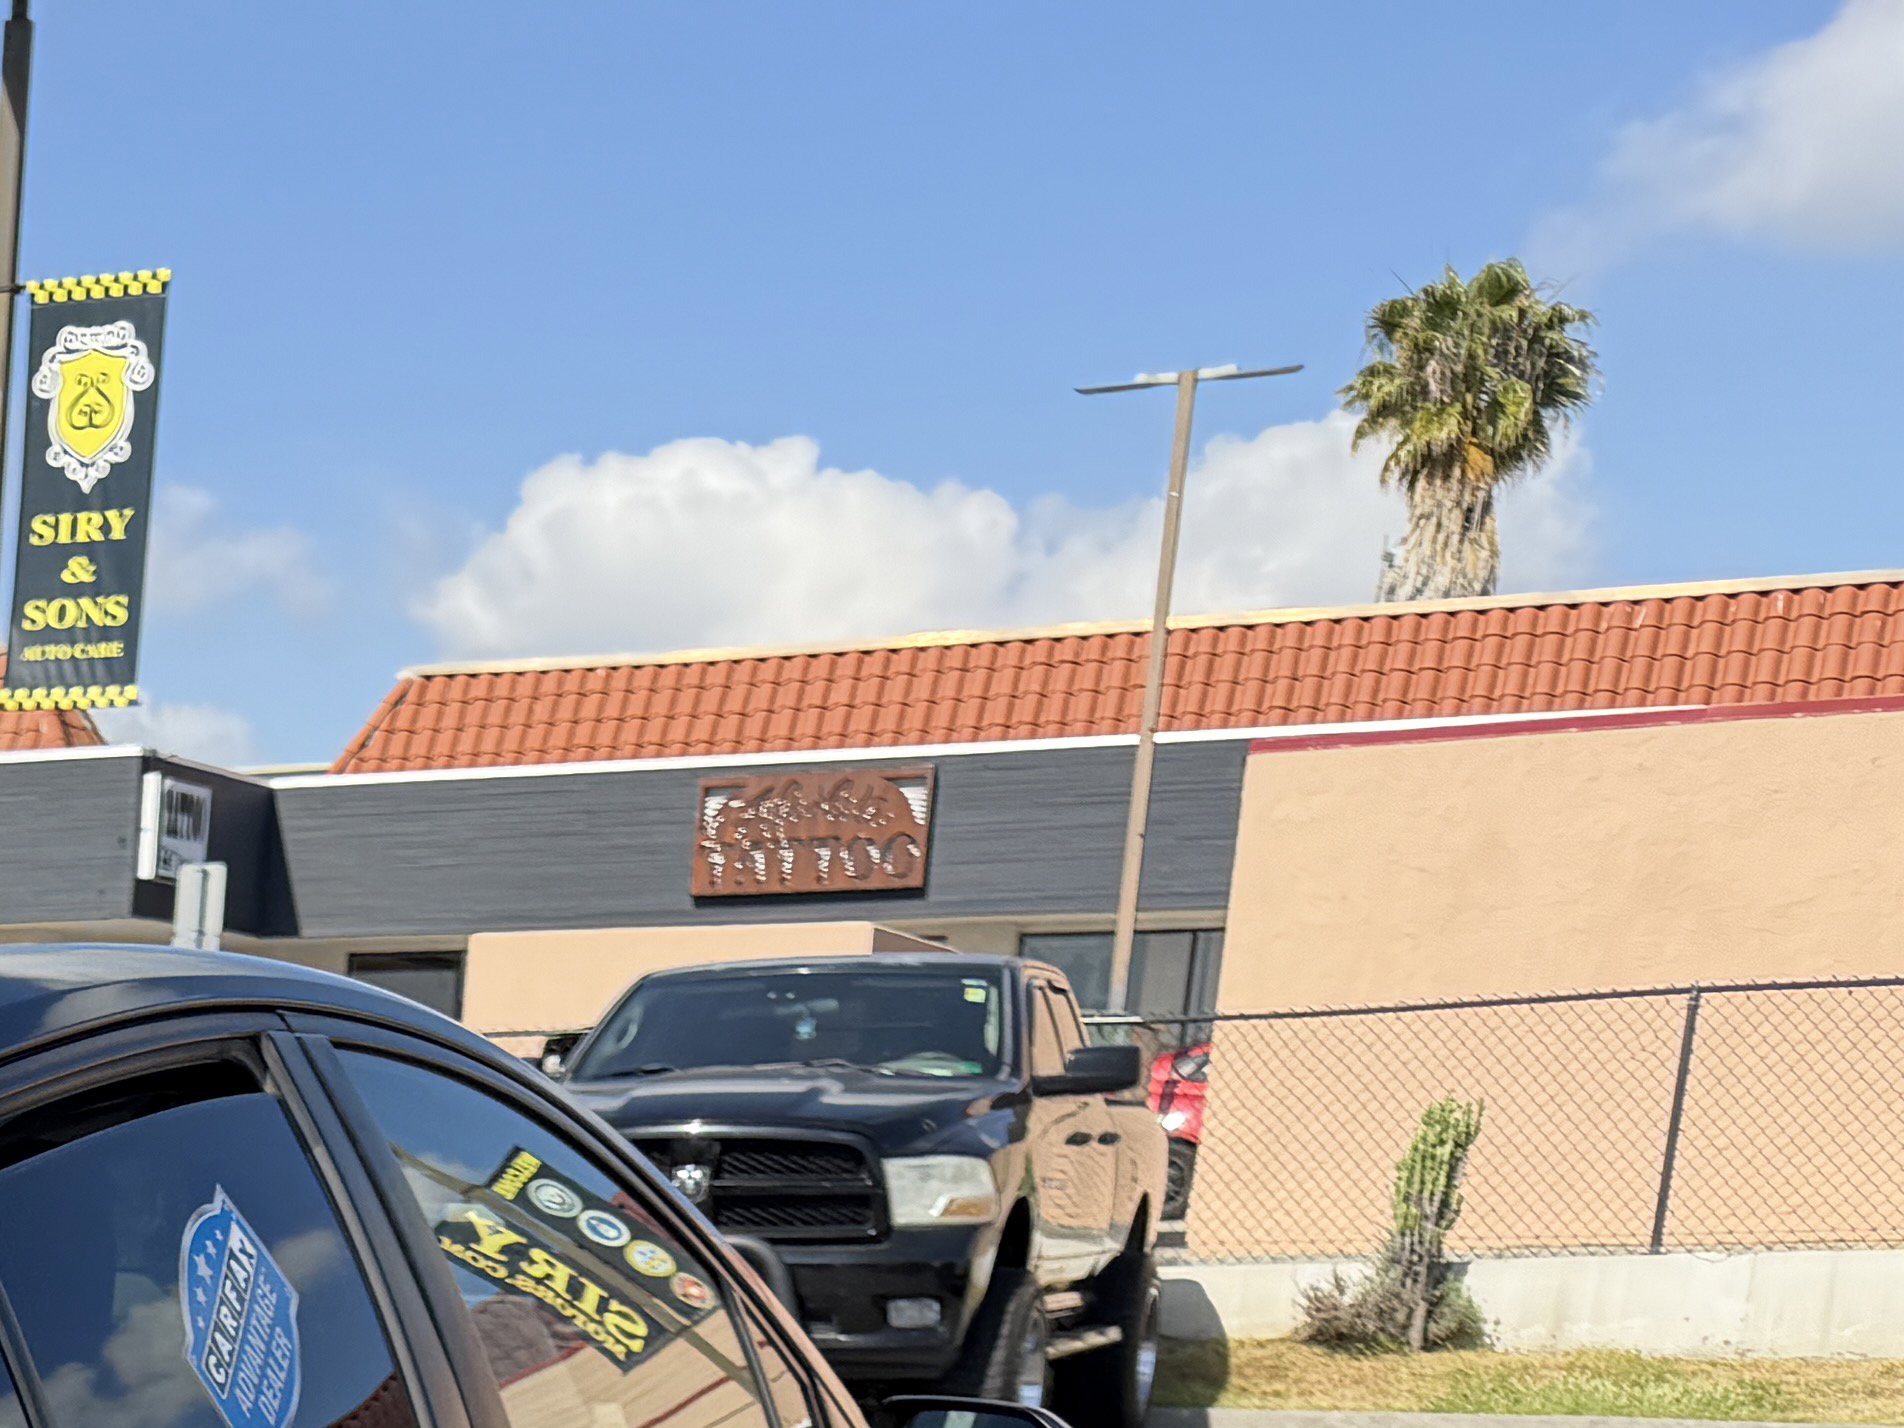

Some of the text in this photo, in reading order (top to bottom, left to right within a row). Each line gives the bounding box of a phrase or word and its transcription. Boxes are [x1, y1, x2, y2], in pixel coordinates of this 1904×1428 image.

[29, 507, 135, 546] SIRY
[60, 556, 97, 584] &
[22, 594, 129, 631] SONS
[205, 1221, 258, 1386] CARFAX
[234, 1278, 278, 1419] ADVANTAGE
[258, 1326, 293, 1427] DEALER
